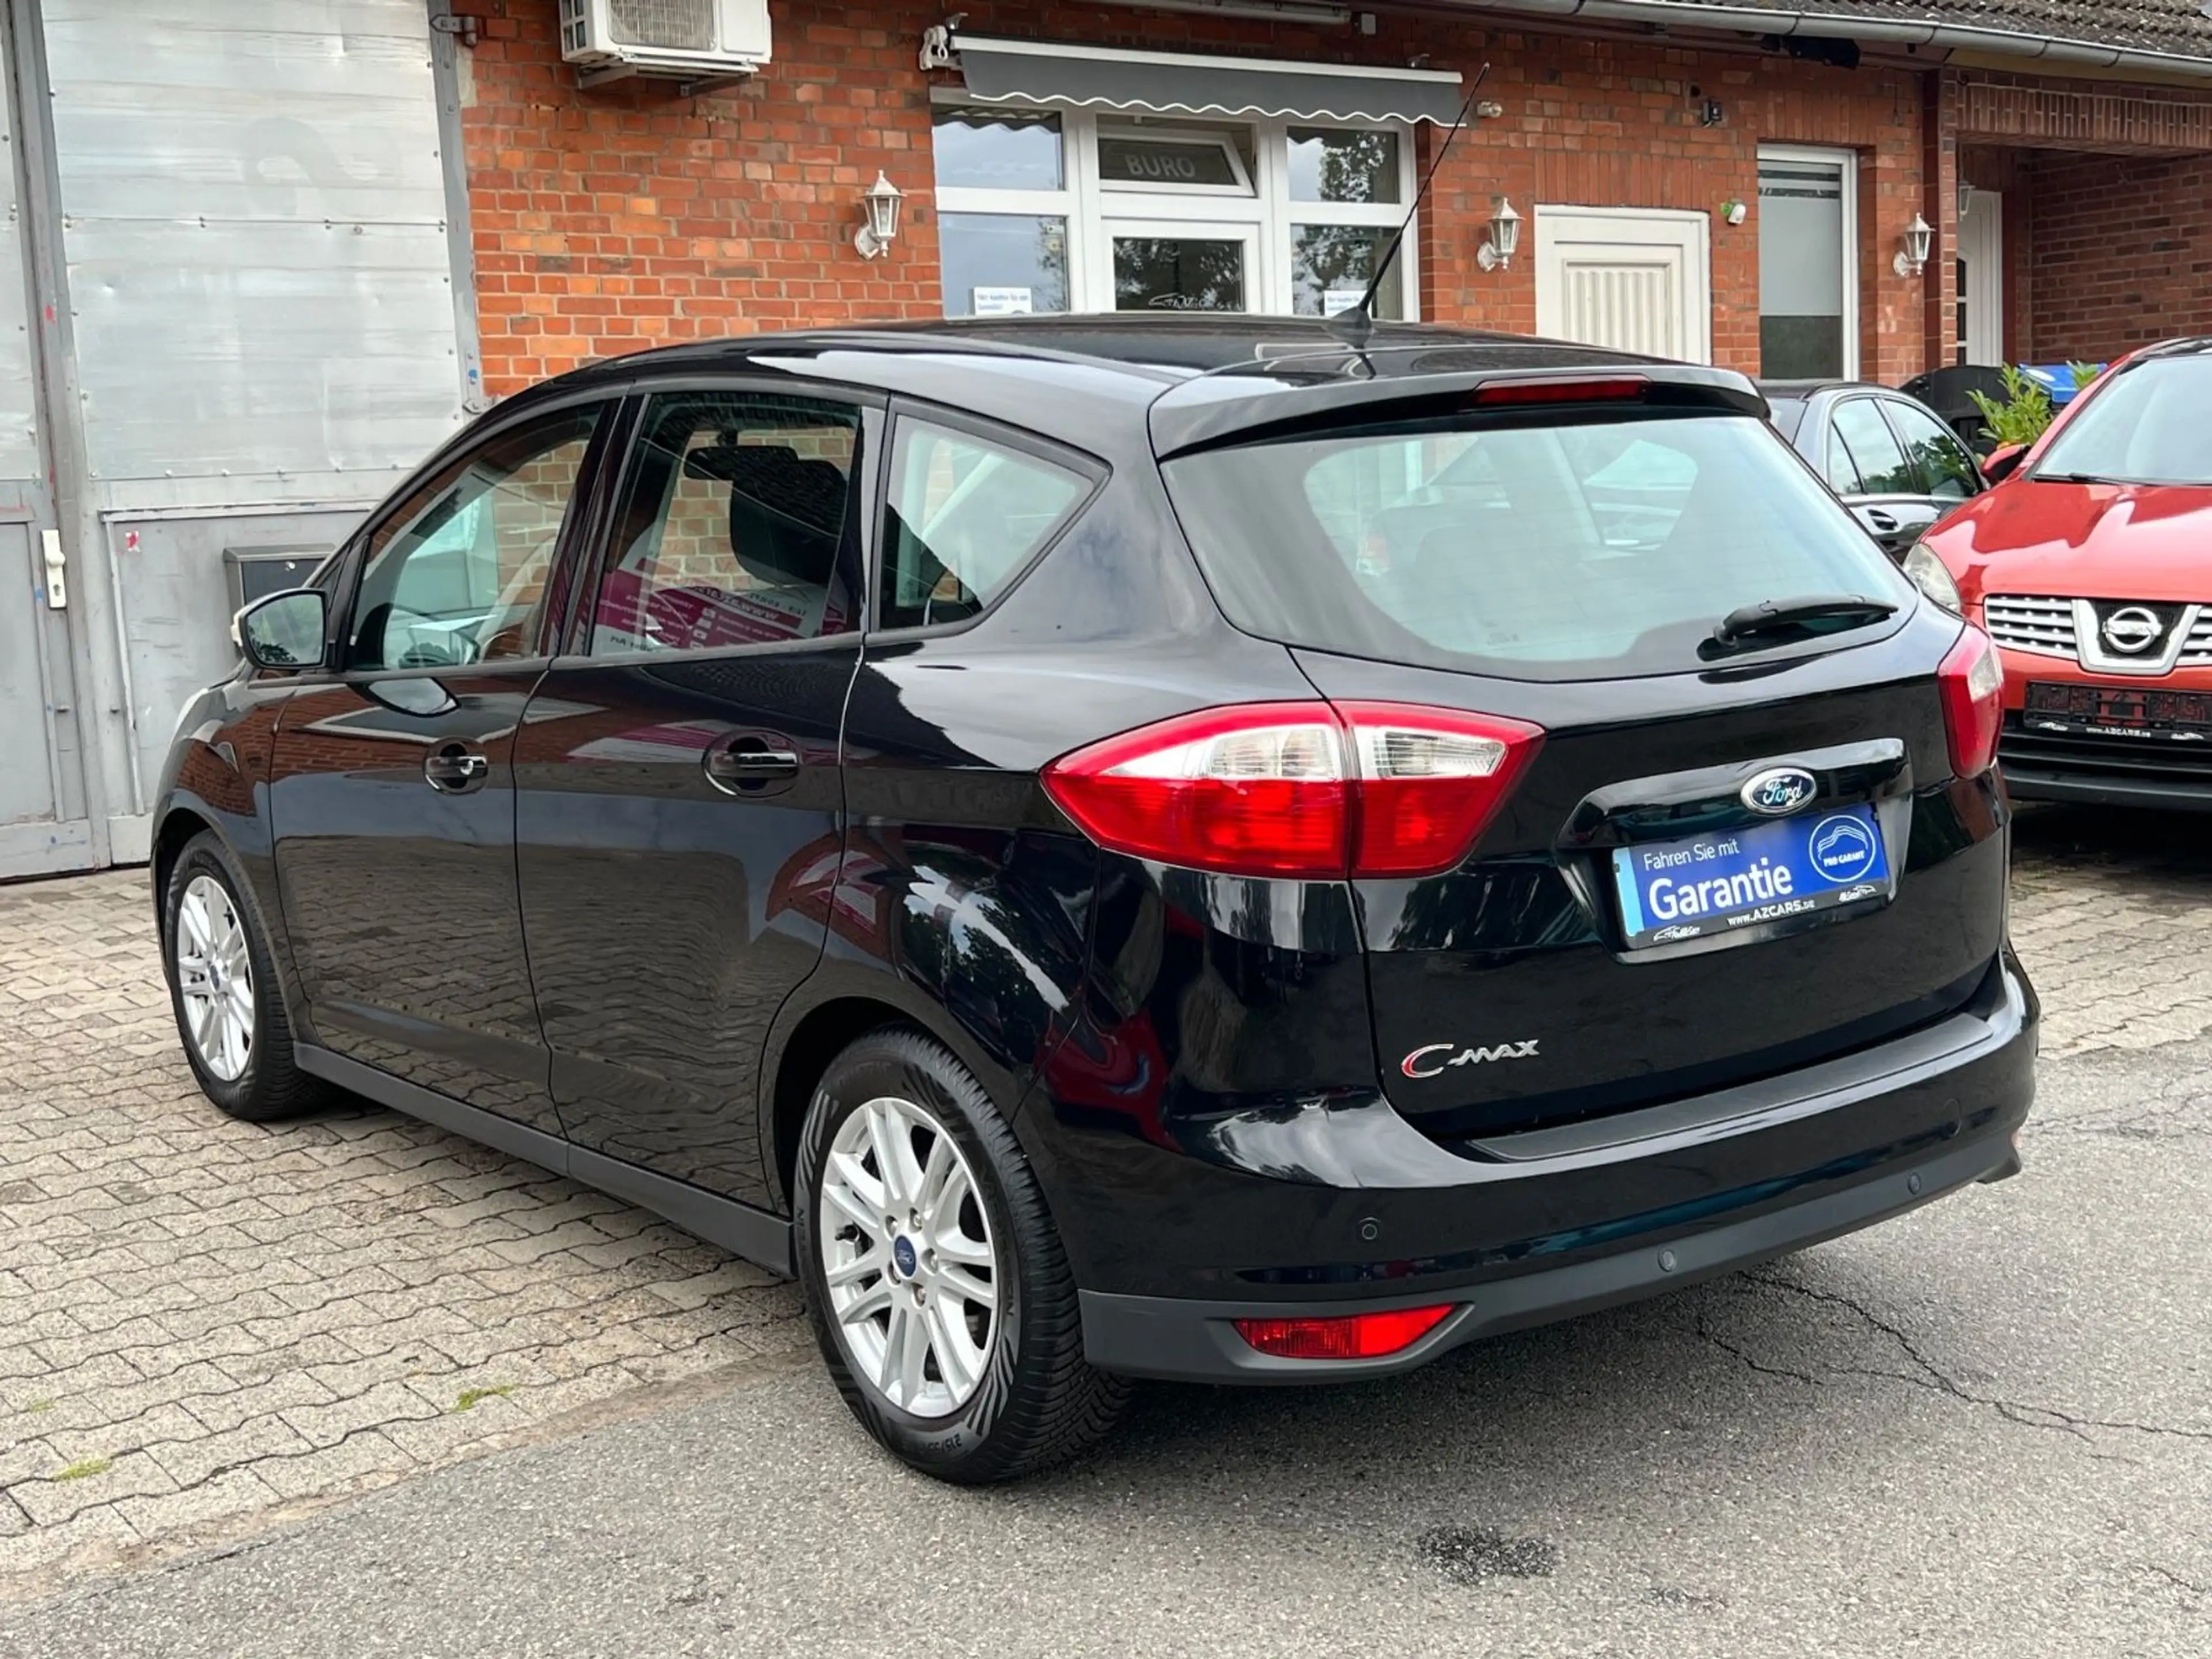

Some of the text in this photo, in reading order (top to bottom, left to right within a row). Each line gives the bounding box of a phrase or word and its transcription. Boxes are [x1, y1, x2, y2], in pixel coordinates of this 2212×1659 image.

[1763, 777, 1804, 805] Ford
[1643, 838, 1740, 872] Fahren Sie mit
[1649, 857, 1793, 921] Garantie
